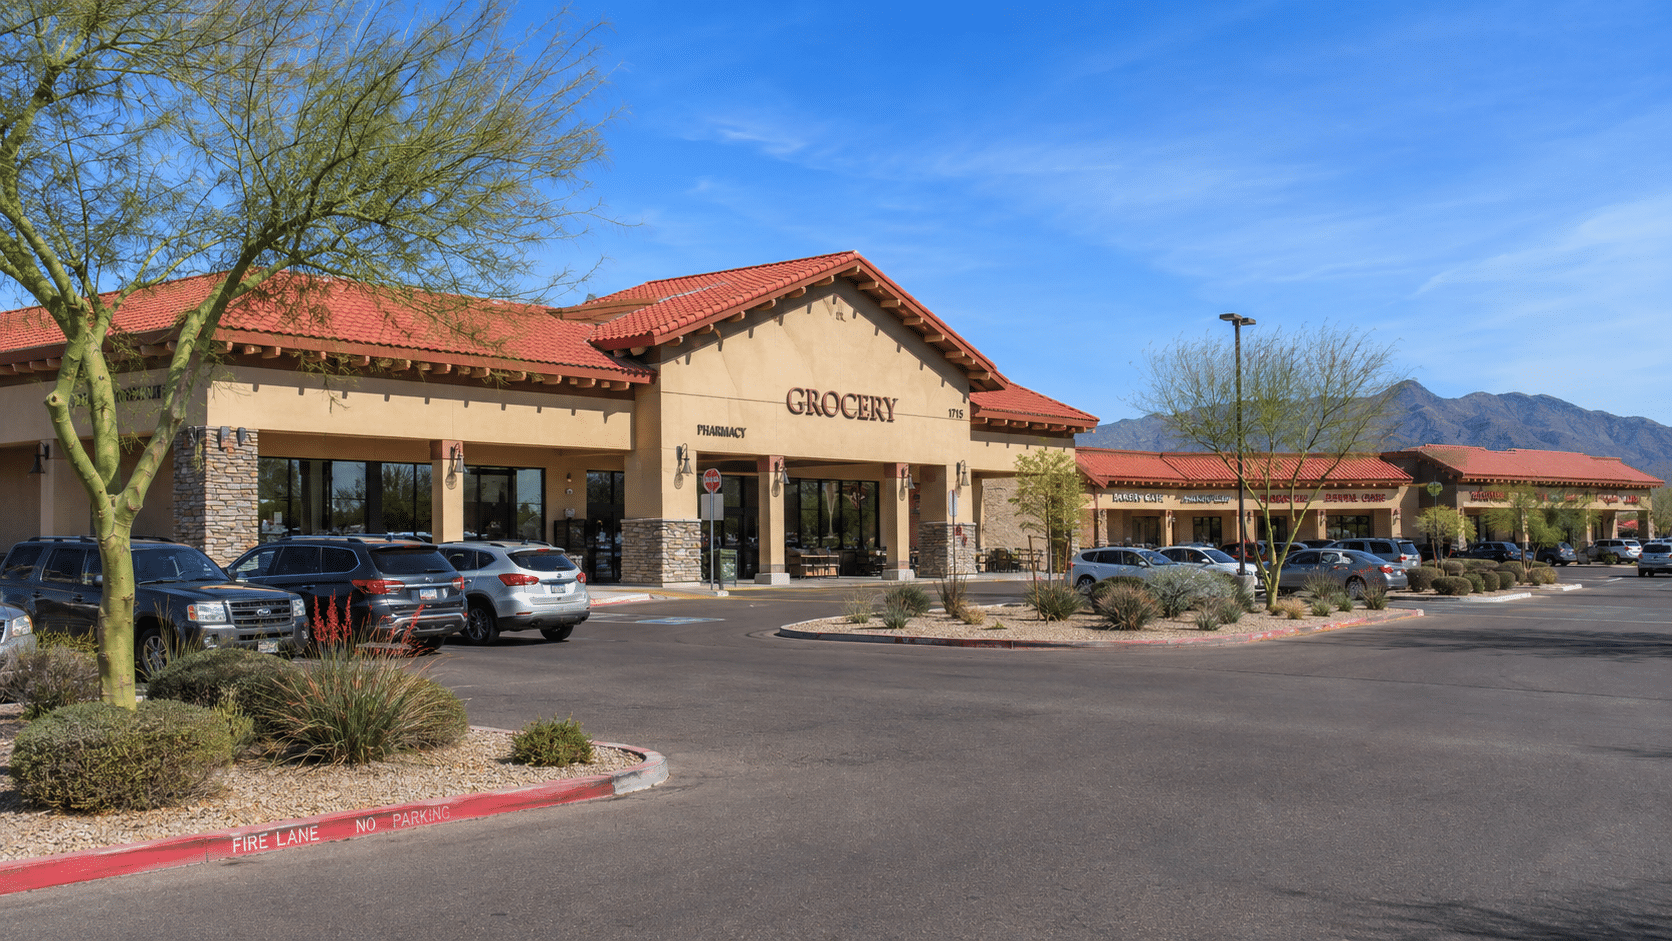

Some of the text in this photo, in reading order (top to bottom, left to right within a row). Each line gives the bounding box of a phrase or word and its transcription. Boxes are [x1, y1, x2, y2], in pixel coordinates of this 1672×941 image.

[786, 386, 899, 423] GROCERY
[697, 424, 747, 439] PHARMACY
[232, 805, 451, 853] FIRE LANE NO PARKING
